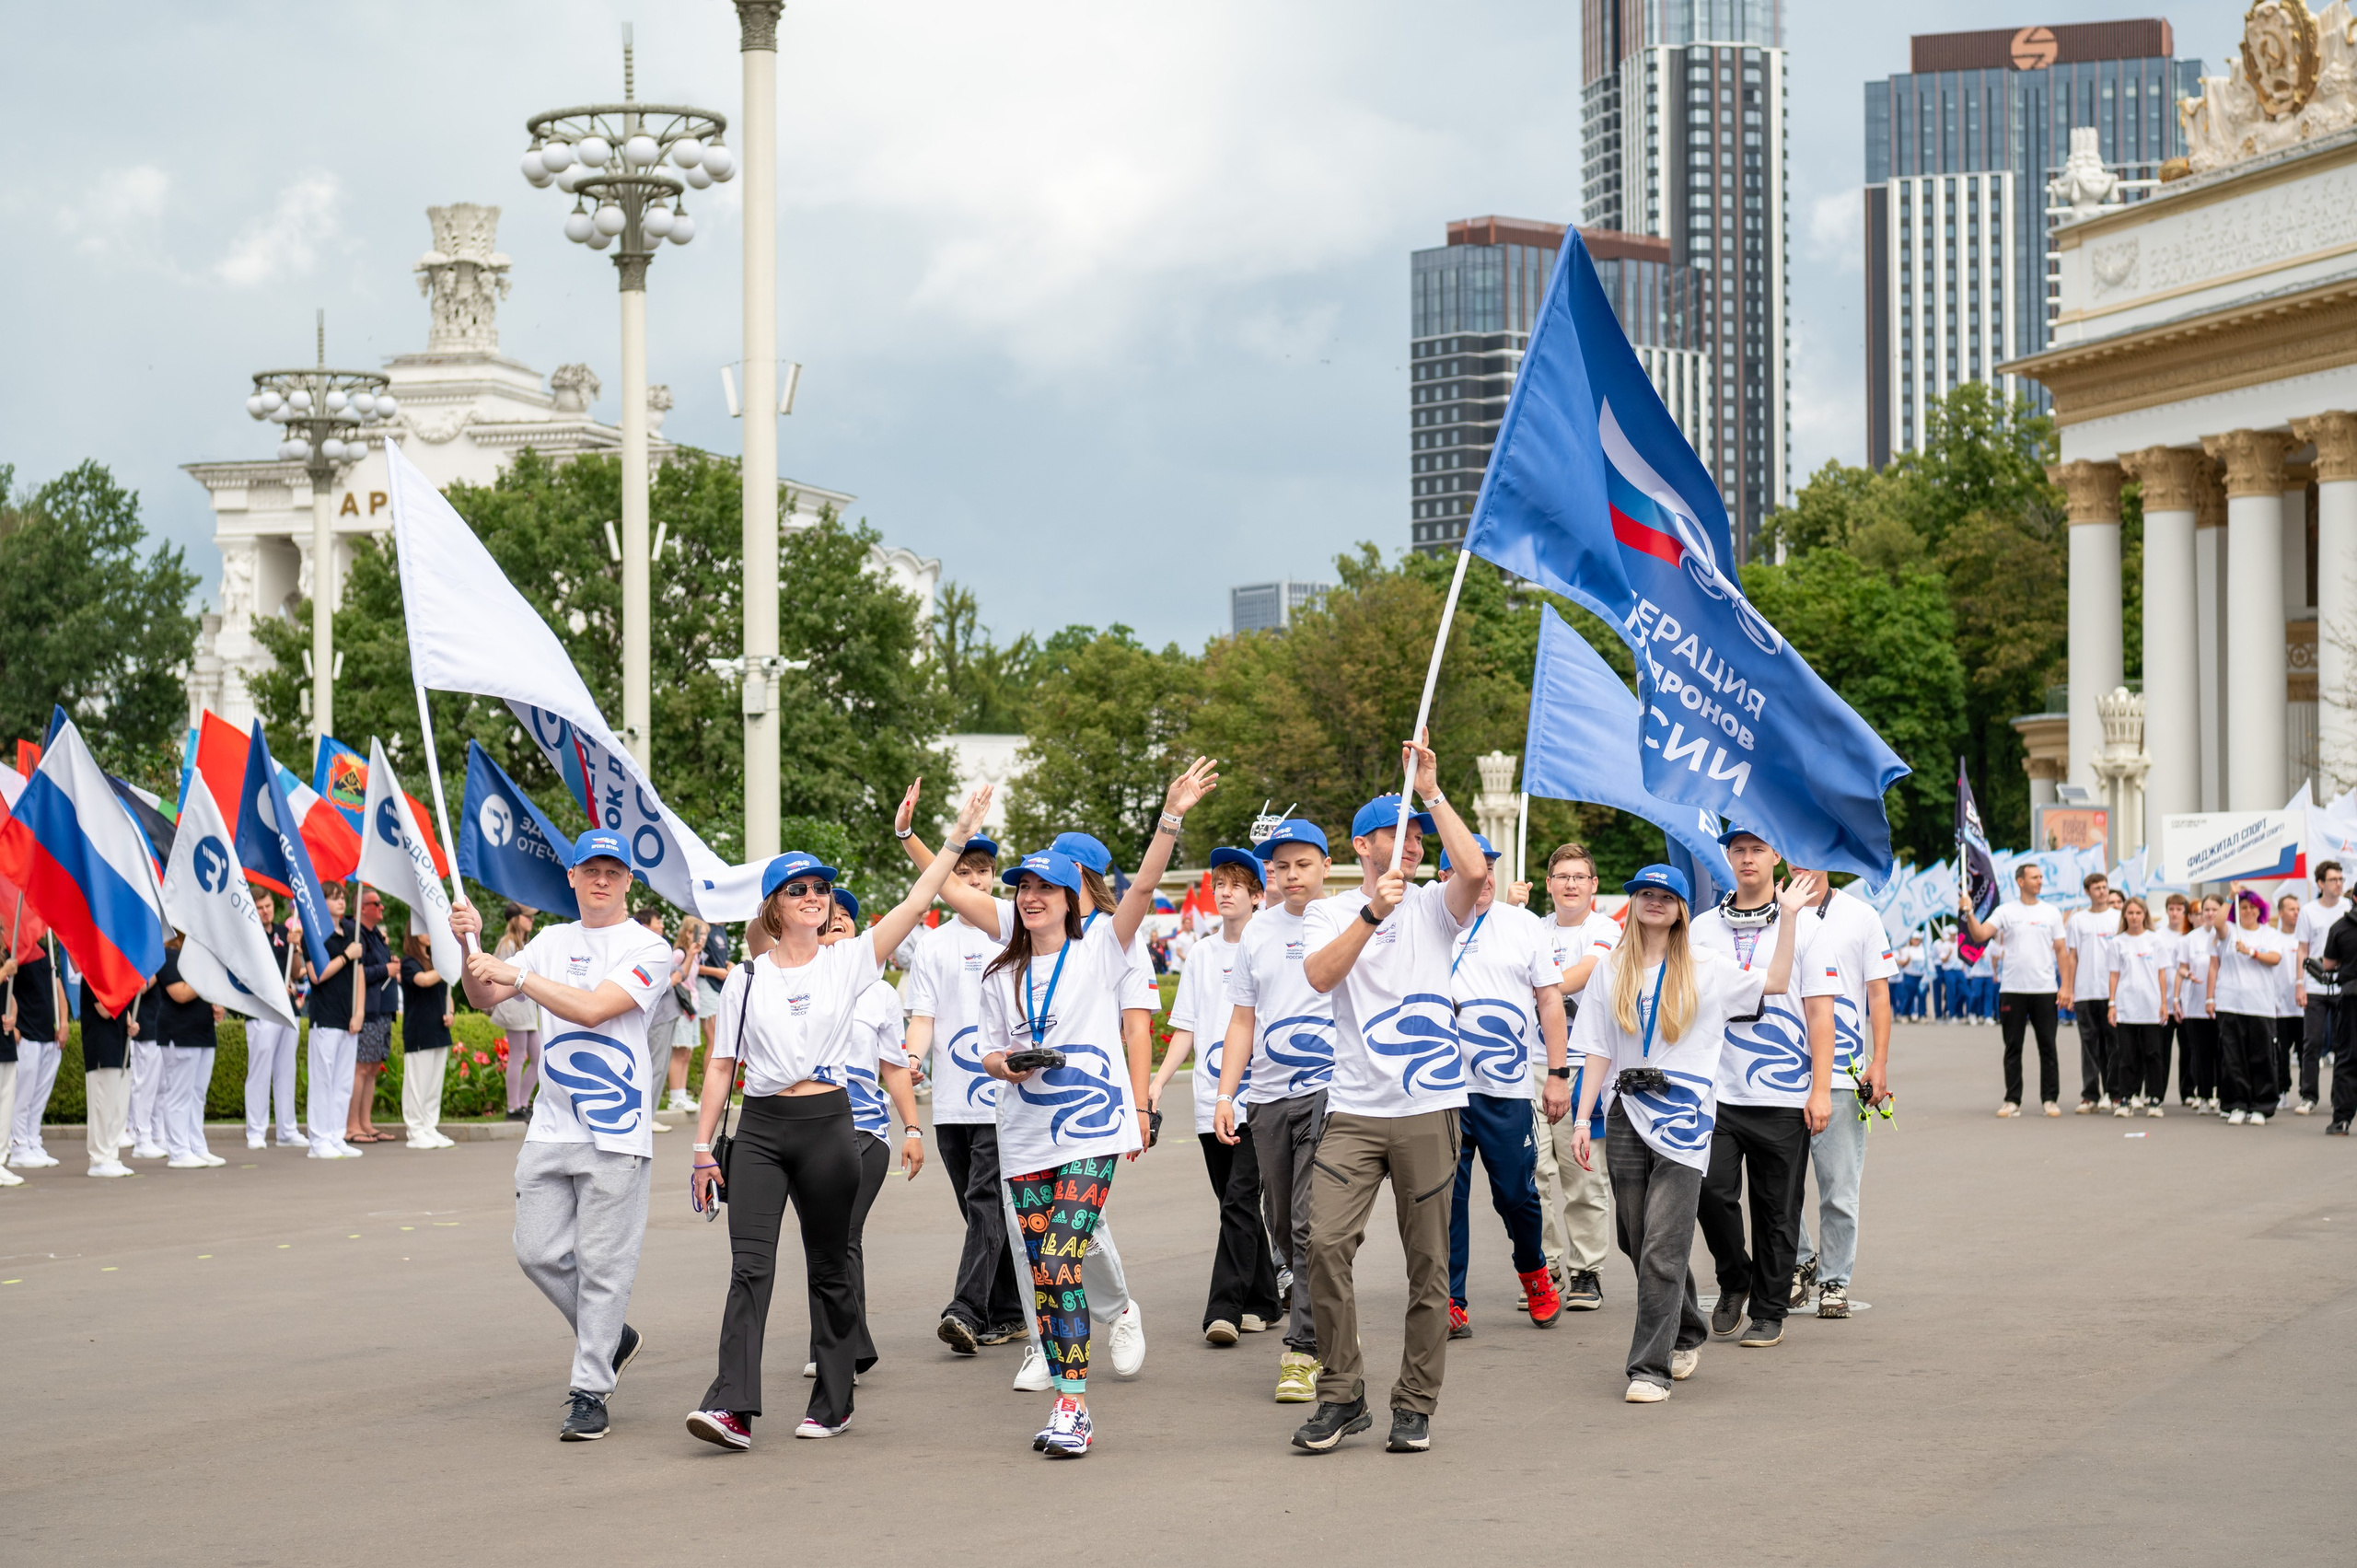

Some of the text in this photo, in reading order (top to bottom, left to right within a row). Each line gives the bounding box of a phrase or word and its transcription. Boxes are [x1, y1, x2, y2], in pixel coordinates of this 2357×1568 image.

[1631, 589, 1767, 722] ЕРАЦИЯ
[1644, 705, 1752, 797] СИИ
[2187, 817, 2268, 867] ФИДЖИТАЛ СПОРТ
